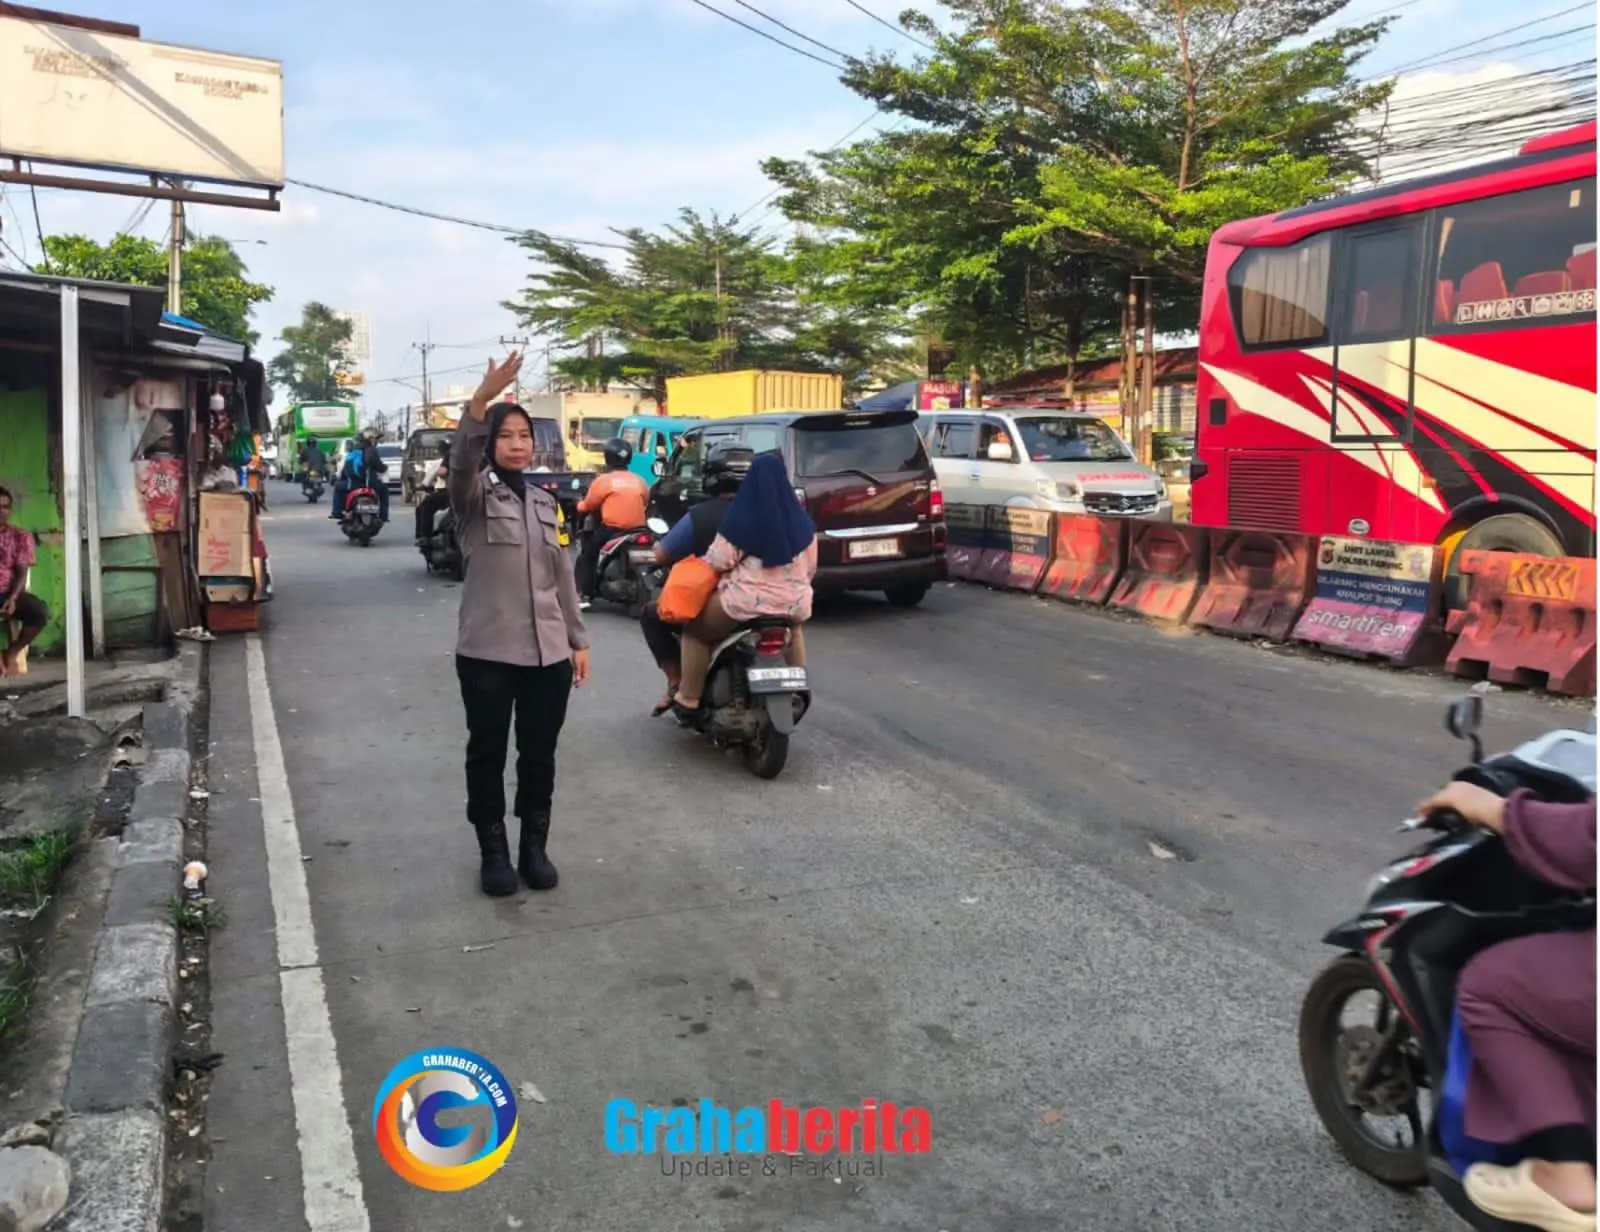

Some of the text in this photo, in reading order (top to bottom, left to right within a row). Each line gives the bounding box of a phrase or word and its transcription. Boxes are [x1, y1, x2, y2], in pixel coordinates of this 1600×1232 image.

[1344, 545, 1396, 558] UNIT LANTAS
[1337, 556, 1369, 567] POLSEK
[1308, 609, 1406, 638] smartfren
